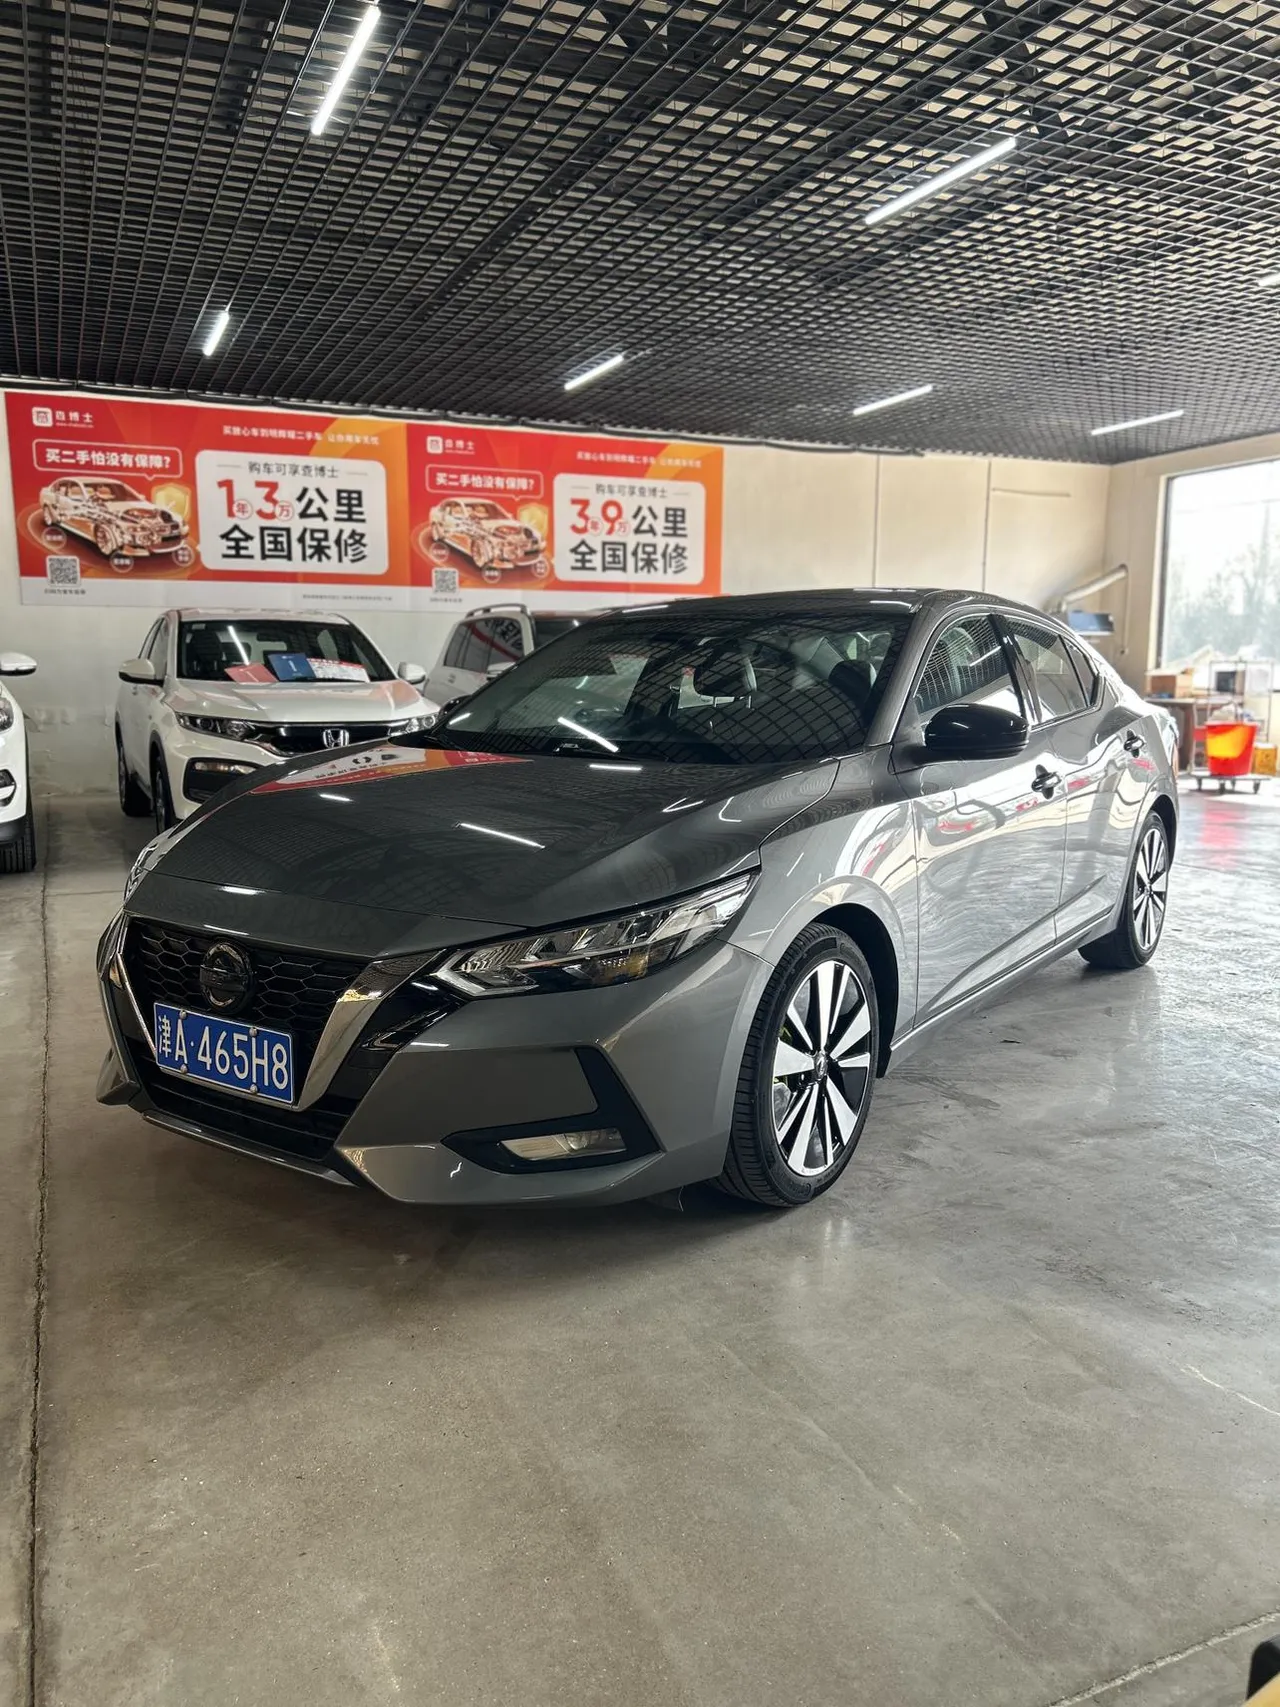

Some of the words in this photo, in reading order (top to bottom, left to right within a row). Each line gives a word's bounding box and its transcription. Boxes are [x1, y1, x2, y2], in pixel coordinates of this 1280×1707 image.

[45, 448, 171, 468] 买二手怕没有保障?
[219, 523, 368, 564] 全国保修
[569, 538, 688, 575] 全国保修
